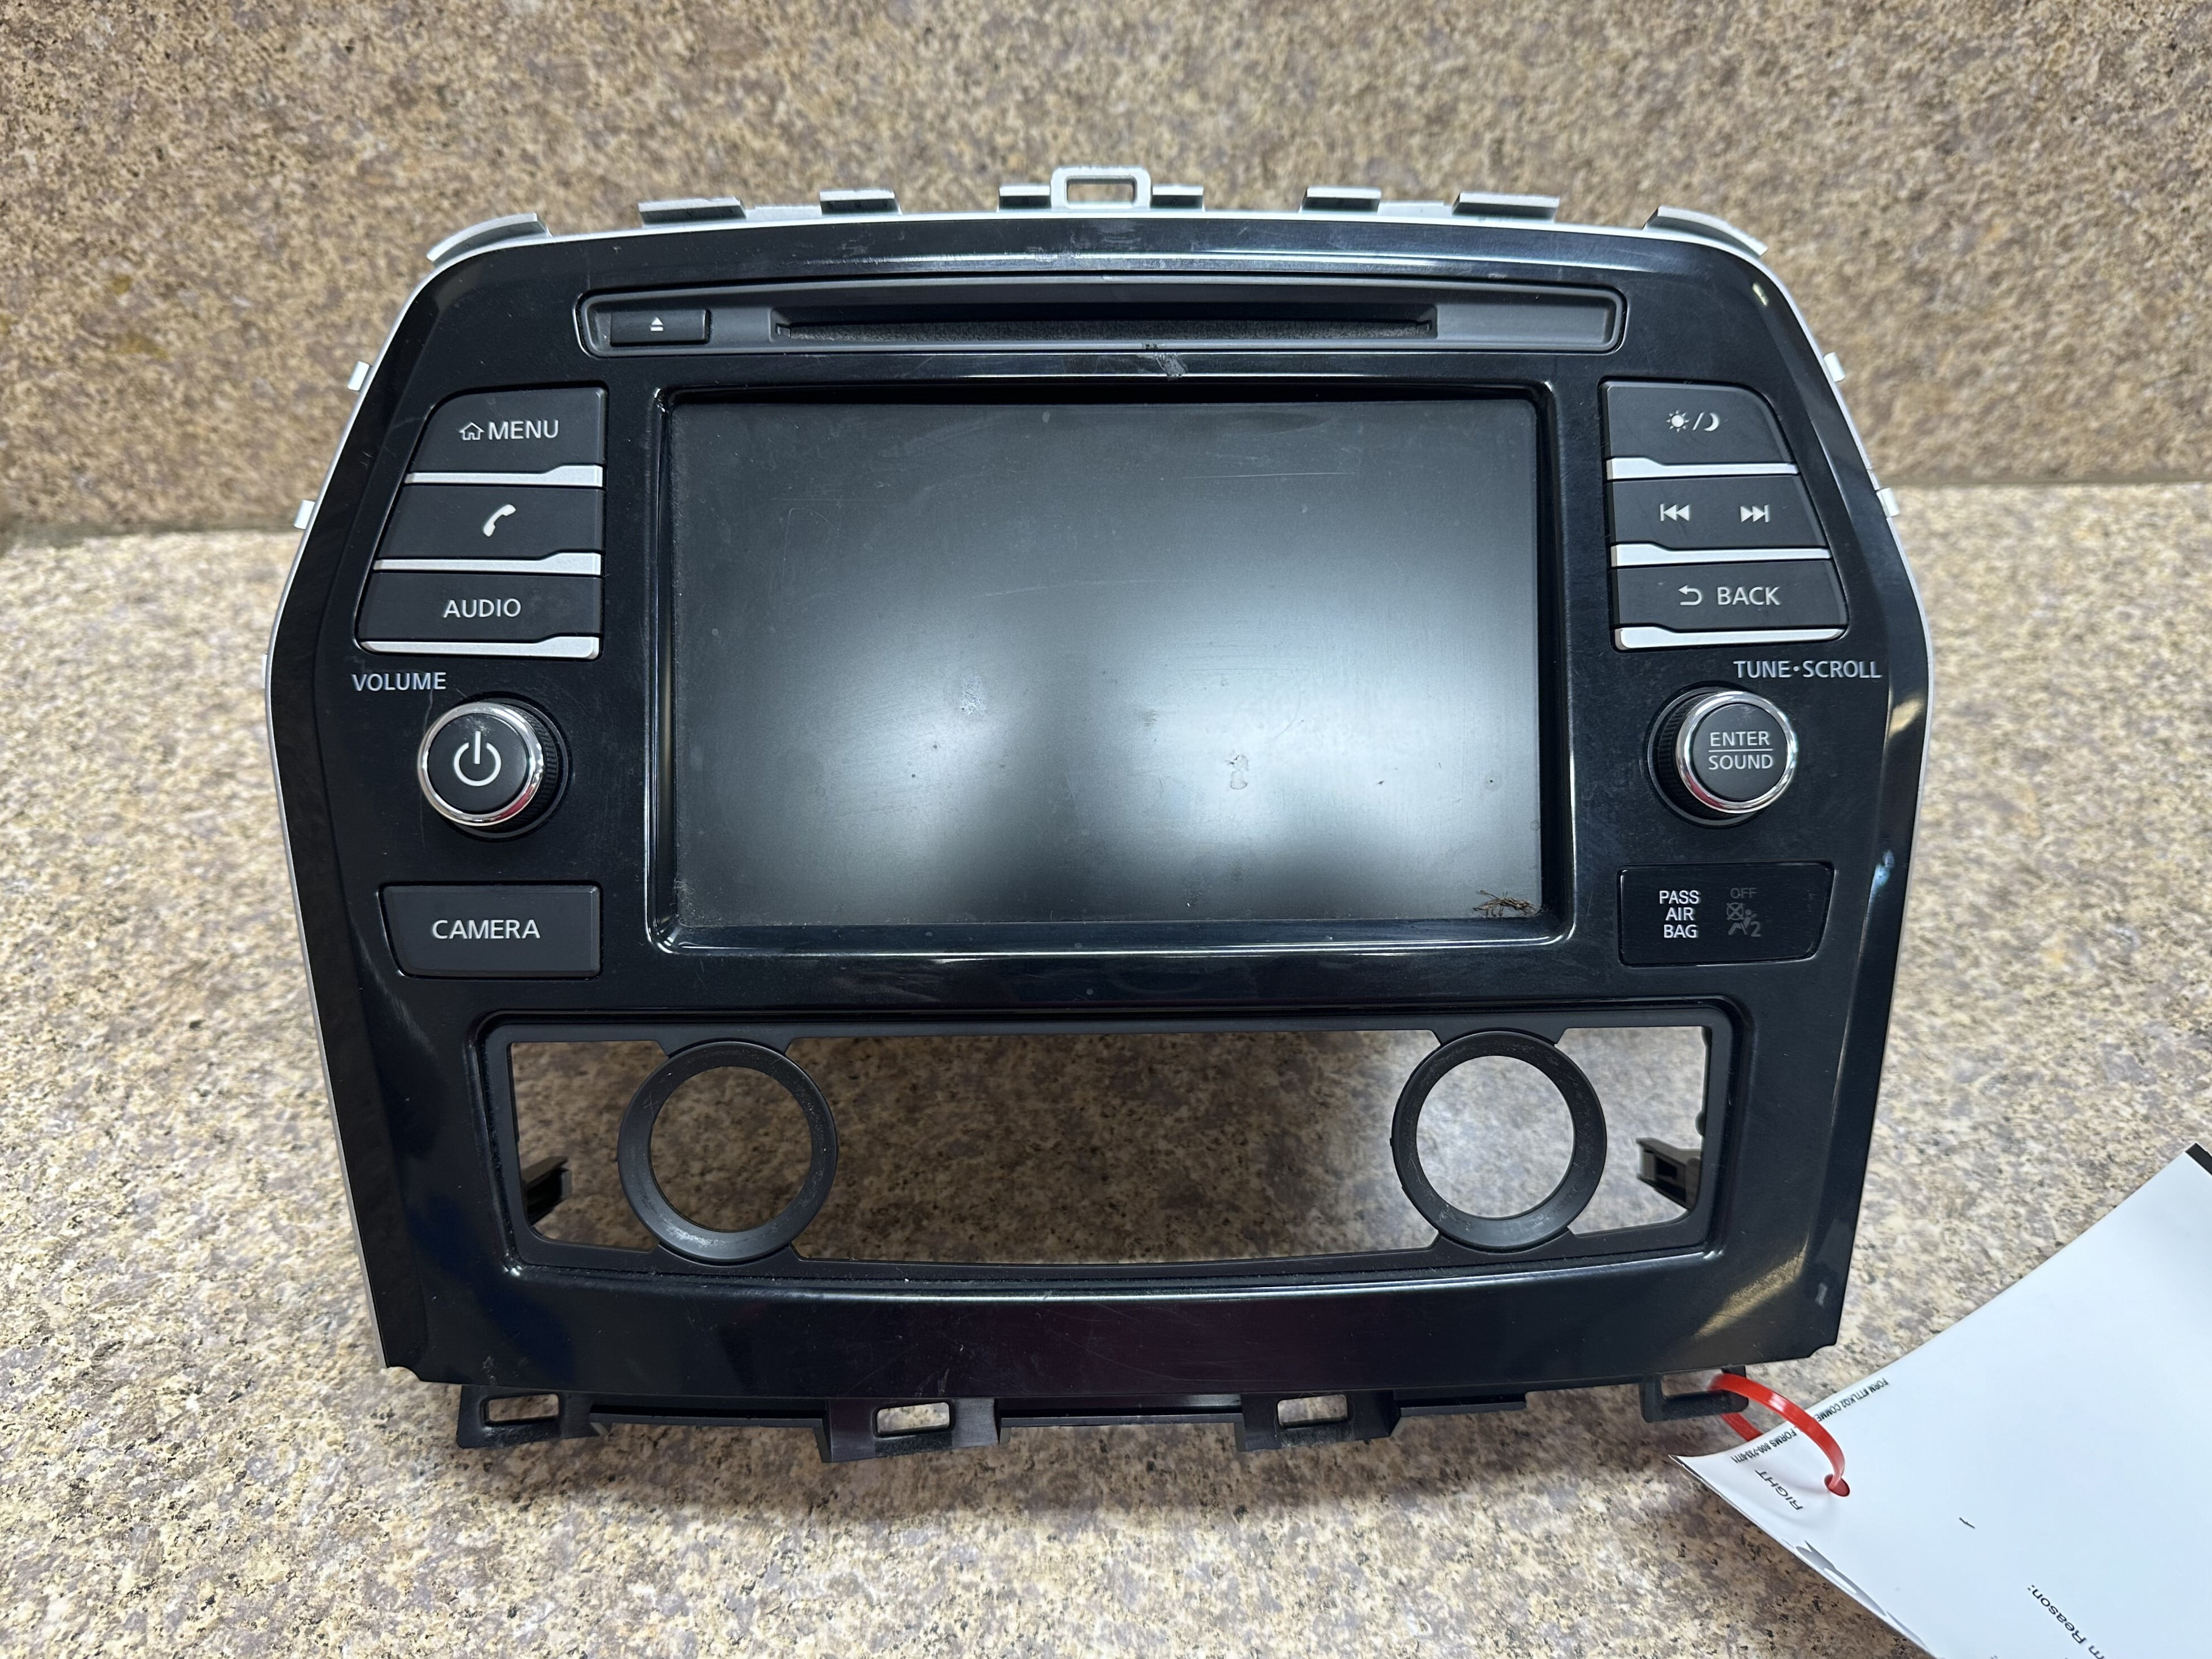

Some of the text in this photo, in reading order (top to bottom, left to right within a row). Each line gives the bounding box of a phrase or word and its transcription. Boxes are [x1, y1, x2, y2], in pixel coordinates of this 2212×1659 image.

[488, 420, 559, 440] MENU
[1717, 586, 1781, 605] BACK
[444, 599, 521, 618] AUDIO
[352, 672, 446, 692] VOLUME
[1710, 731, 1770, 747] ENTER
[1708, 754, 1773, 770] SOUND
[1659, 890, 1701, 904] PASS
[1730, 888, 1757, 899] OFF
[1665, 907, 1694, 921] AIR
[432, 919, 541, 940] CAMERA
[1664, 924, 1698, 938] BAG
[1867, 1377, 1889, 1393] FORM
[1814, 1403, 1841, 1422] COMME
[1769, 1428, 1797, 1447] FORMS
[1754, 1469, 1803, 1511] RIGHT
[2027, 1585, 2087, 1644] Reason:
